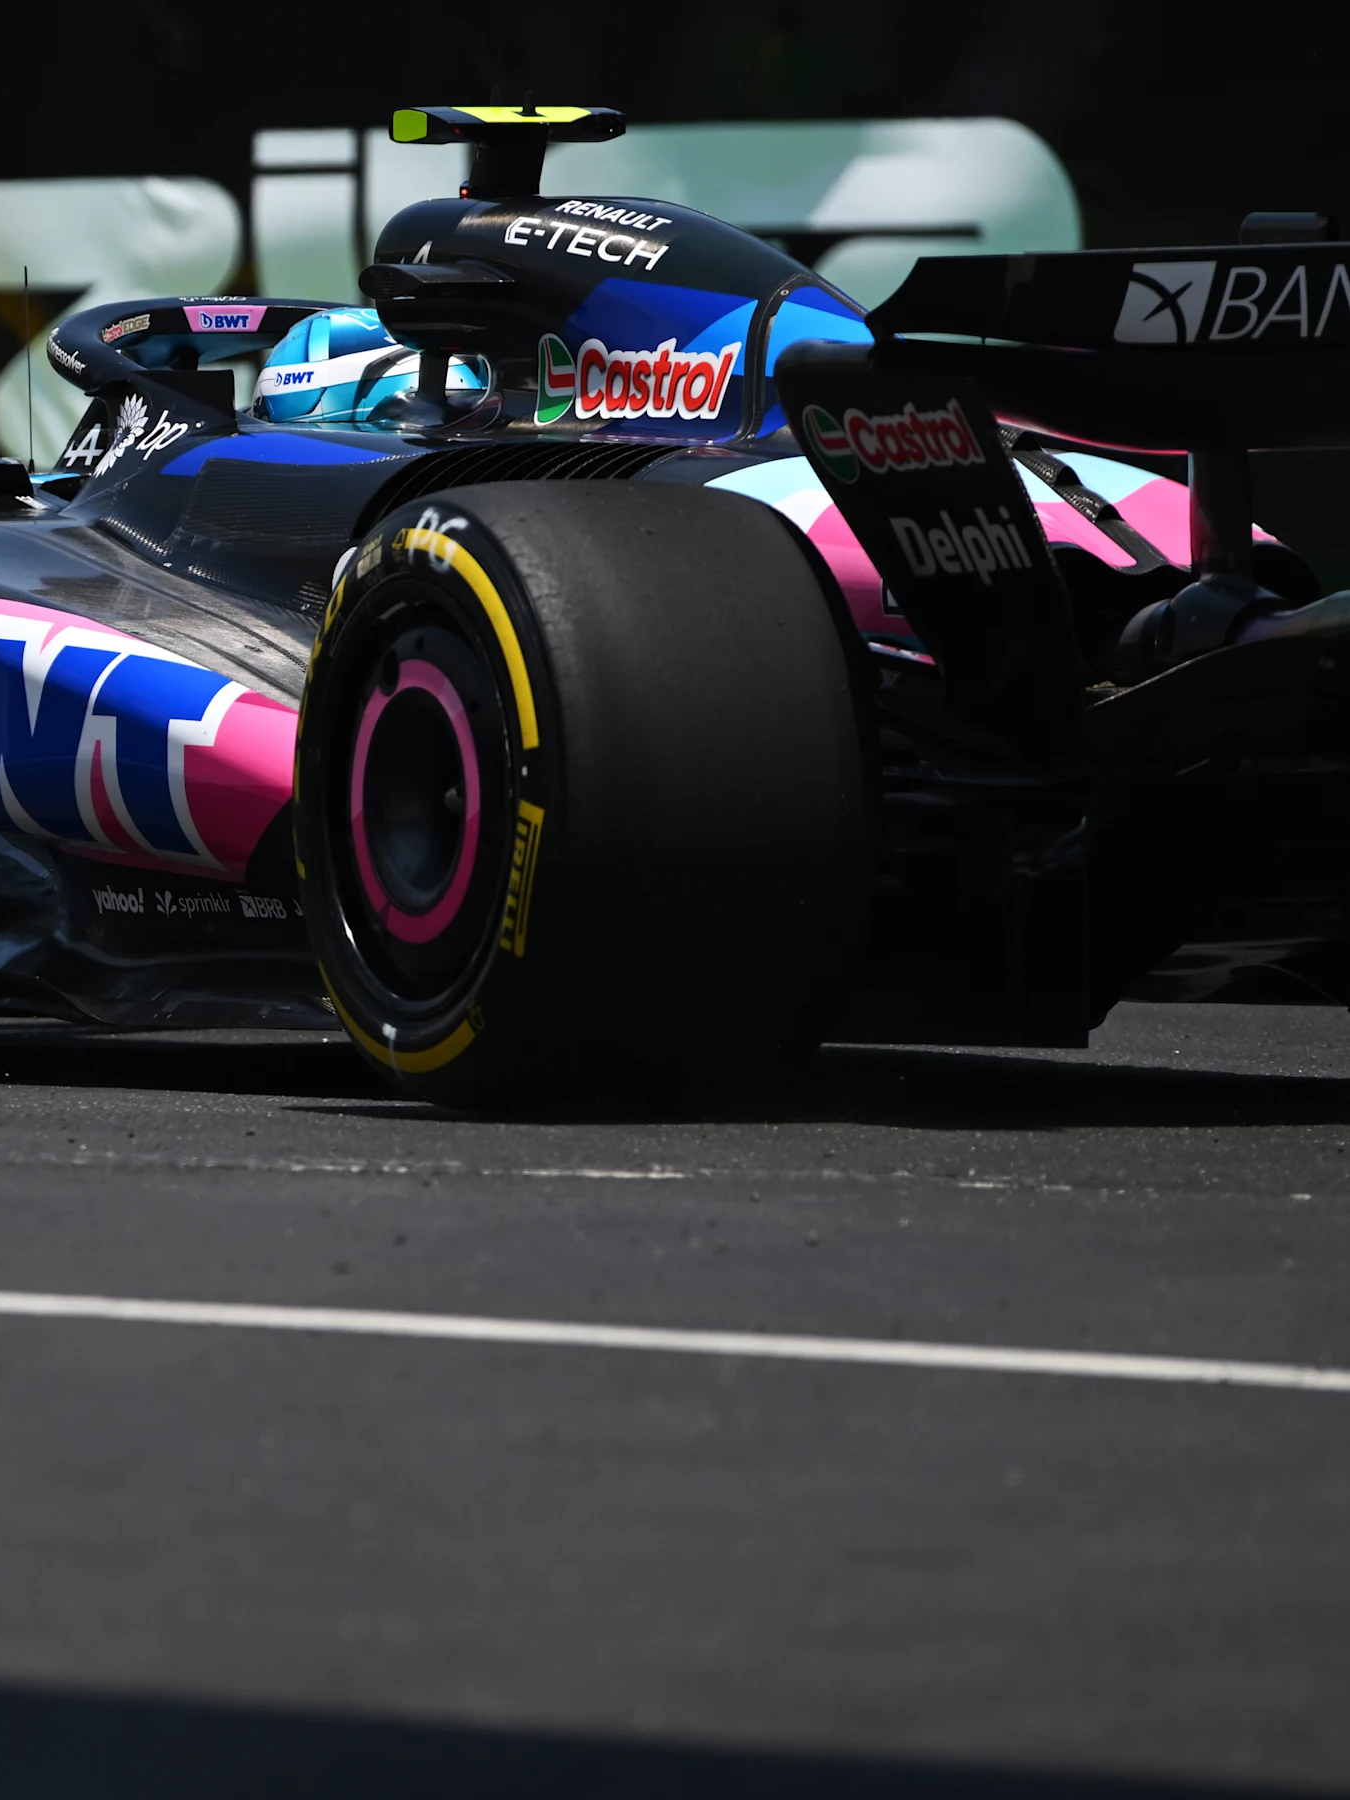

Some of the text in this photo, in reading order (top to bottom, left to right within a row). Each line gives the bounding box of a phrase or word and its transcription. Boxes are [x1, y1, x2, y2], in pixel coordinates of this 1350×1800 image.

[555, 200, 672, 231] RENAULT
[505, 216, 670, 271] E-TECH
[123, 314, 150, 335] EDGE
[214, 314, 249, 329] BWT
[283, 371, 314, 385] BWT
[579, 345, 735, 413] Castrol
[136, 409, 189, 460] bp
[847, 404, 981, 468] Castrol
[889, 505, 1033, 587] Delphi
[92, 885, 144, 914] yahoo!
[179, 892, 231, 919] sprinklr
[253, 896, 287, 920] BRB
[500, 800, 545, 957] PIRELLI
